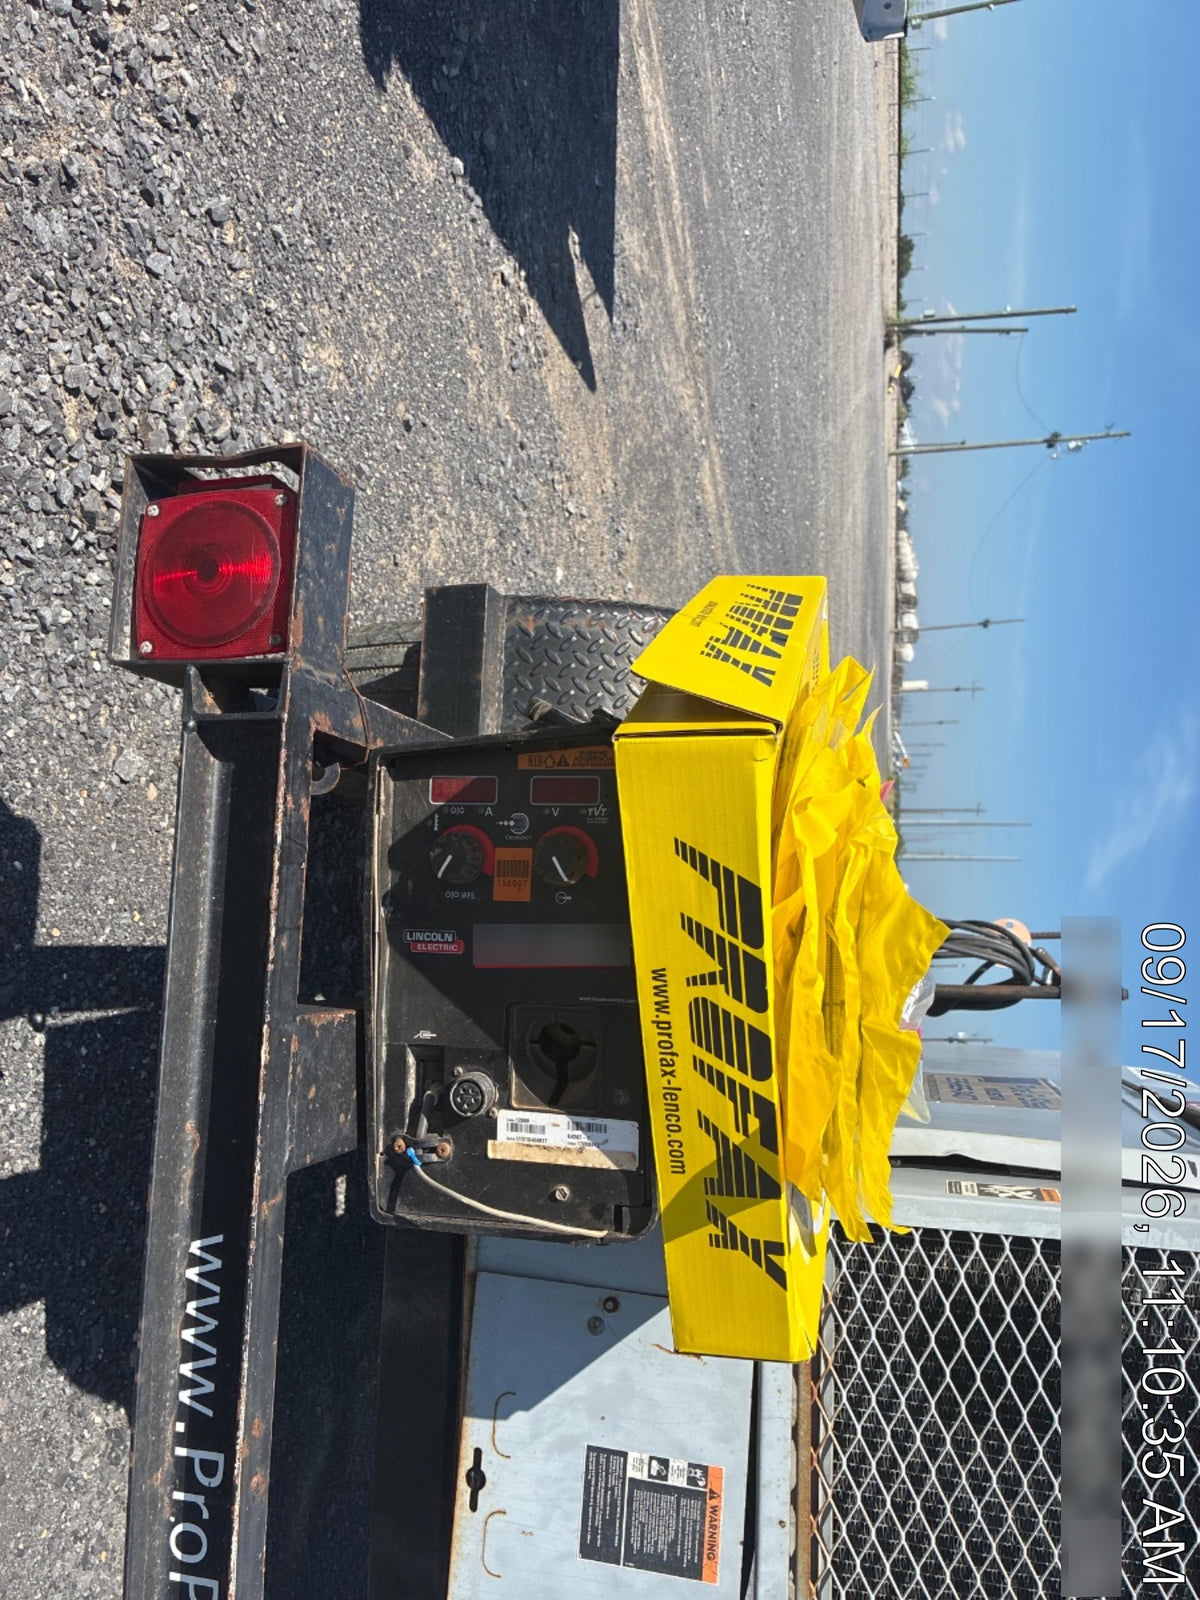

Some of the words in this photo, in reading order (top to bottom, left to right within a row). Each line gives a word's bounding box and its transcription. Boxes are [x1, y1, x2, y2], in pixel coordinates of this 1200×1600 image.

[699, 584, 804, 688] PROFAX
[485, 807, 493, 816] A
[551, 807, 560, 816] V
[406, 931, 454, 942] LINCOLN
[416, 943, 458, 952] ELECTRIC
[650, 967, 689, 1176] www.profax-lenco.com
[673, 837, 787, 1292] PROFAX
[168, 1233, 226, 1600] www.ProP
[706, 1505, 718, 1561] WARNING
